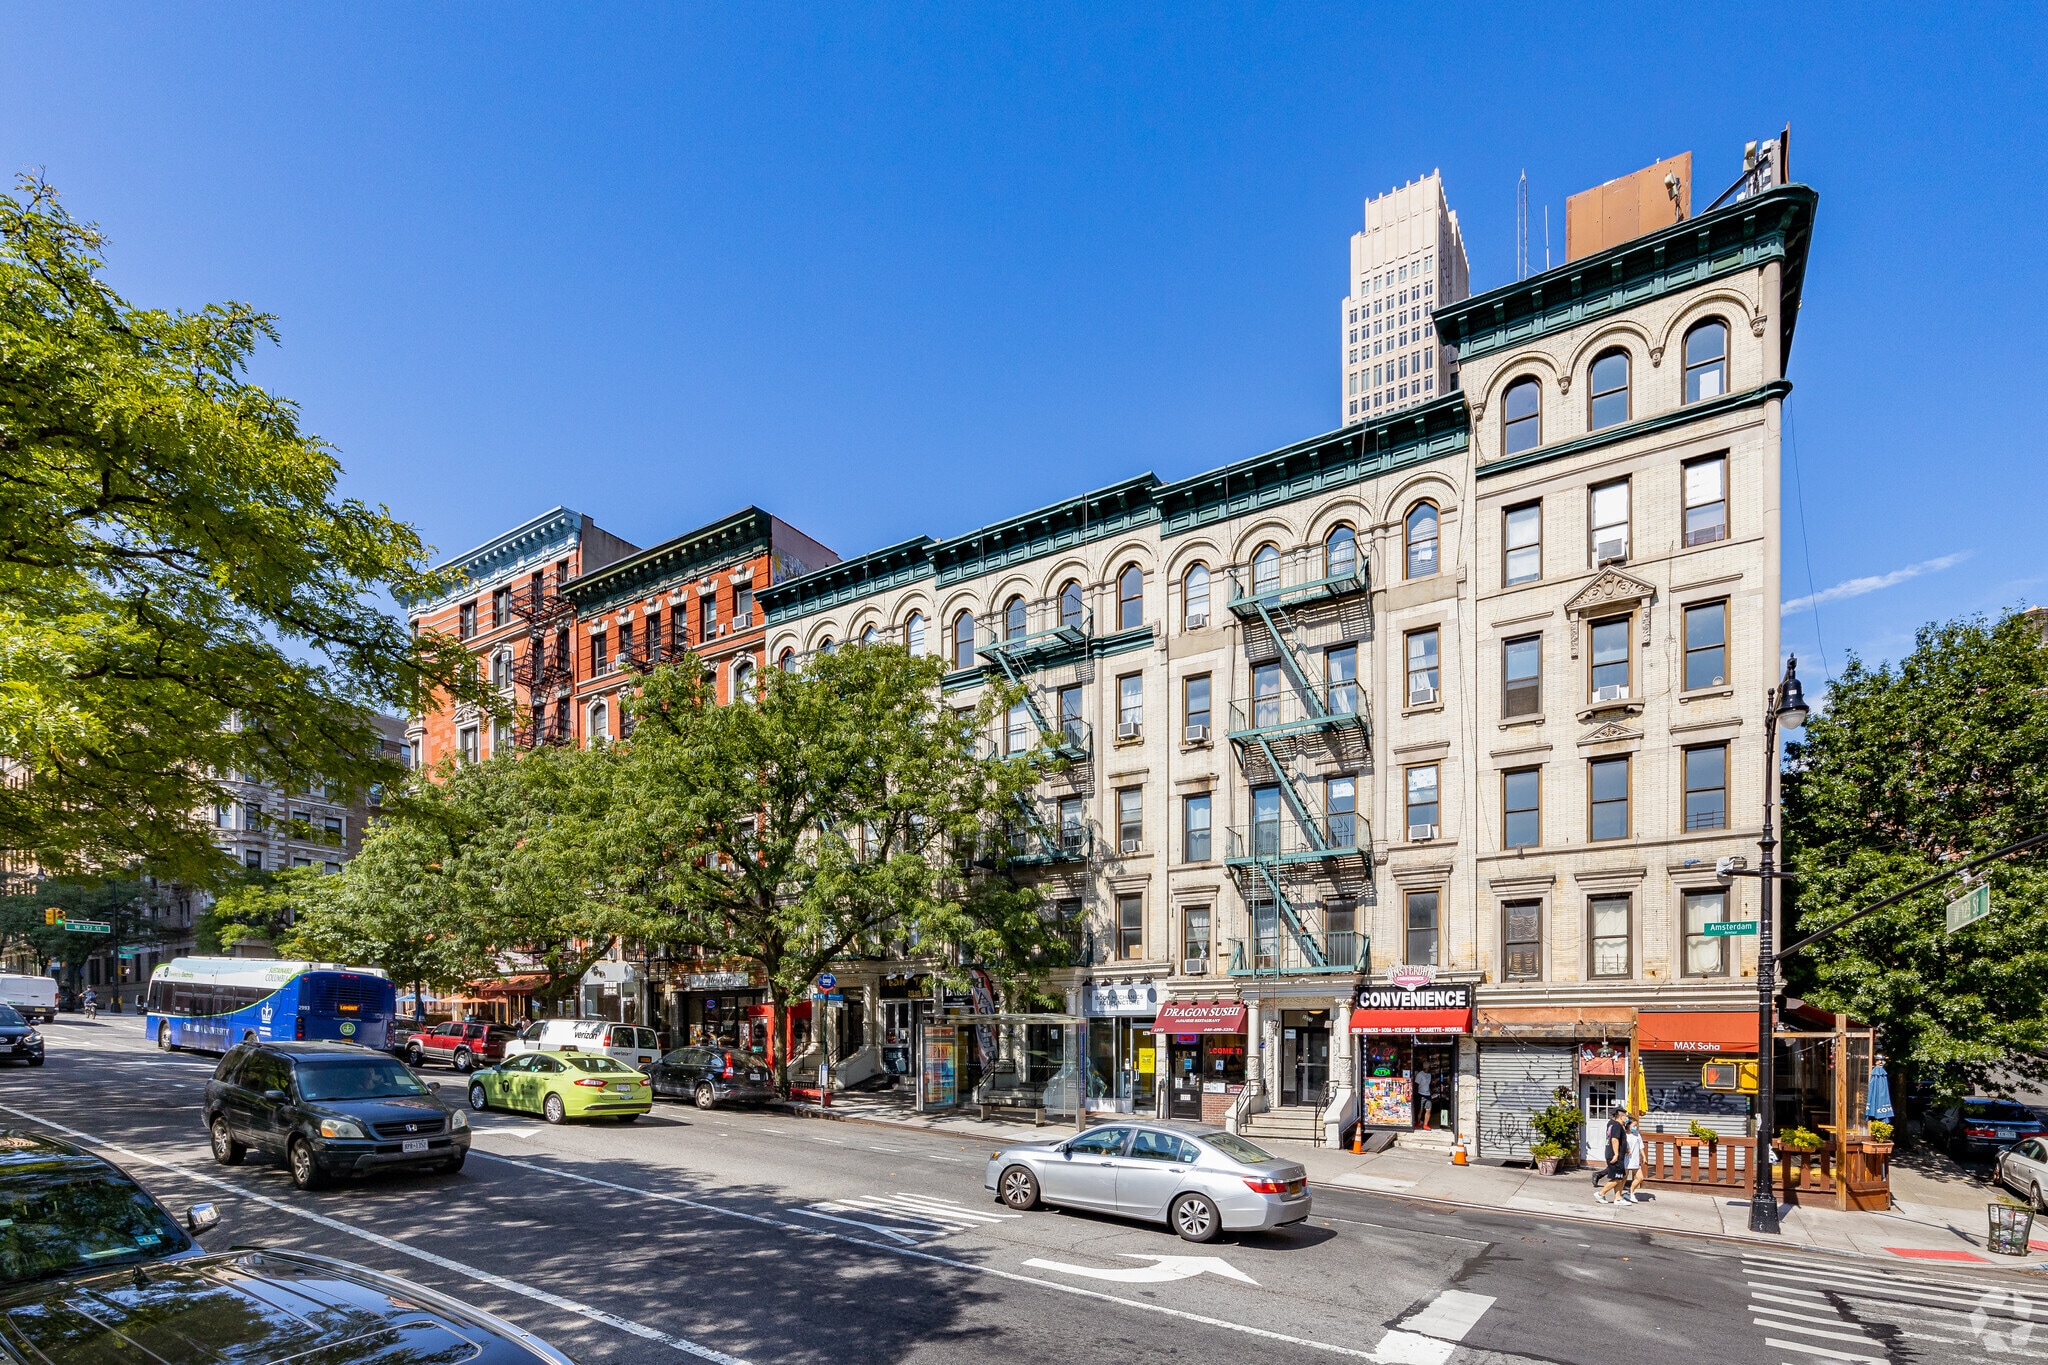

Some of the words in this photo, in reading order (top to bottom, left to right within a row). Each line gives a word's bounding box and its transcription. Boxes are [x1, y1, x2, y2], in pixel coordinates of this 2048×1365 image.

[1972, 895, 1980, 915] St
[1710, 923, 1753, 931] Amsterdam
[1386, 964, 1437, 981] AMSTERDAM
[1360, 990, 1466, 1007] CONVENIENCE
[1163, 1007, 1208, 1017] DRAGON
[1208, 1006, 1241, 1017] SUSHI
[574, 1030, 598, 1040] verizon
[1674, 1041, 1696, 1050] MAX
[1697, 1042, 1720, 1051] Soha
[1373, 1067, 1391, 1077] ATM
